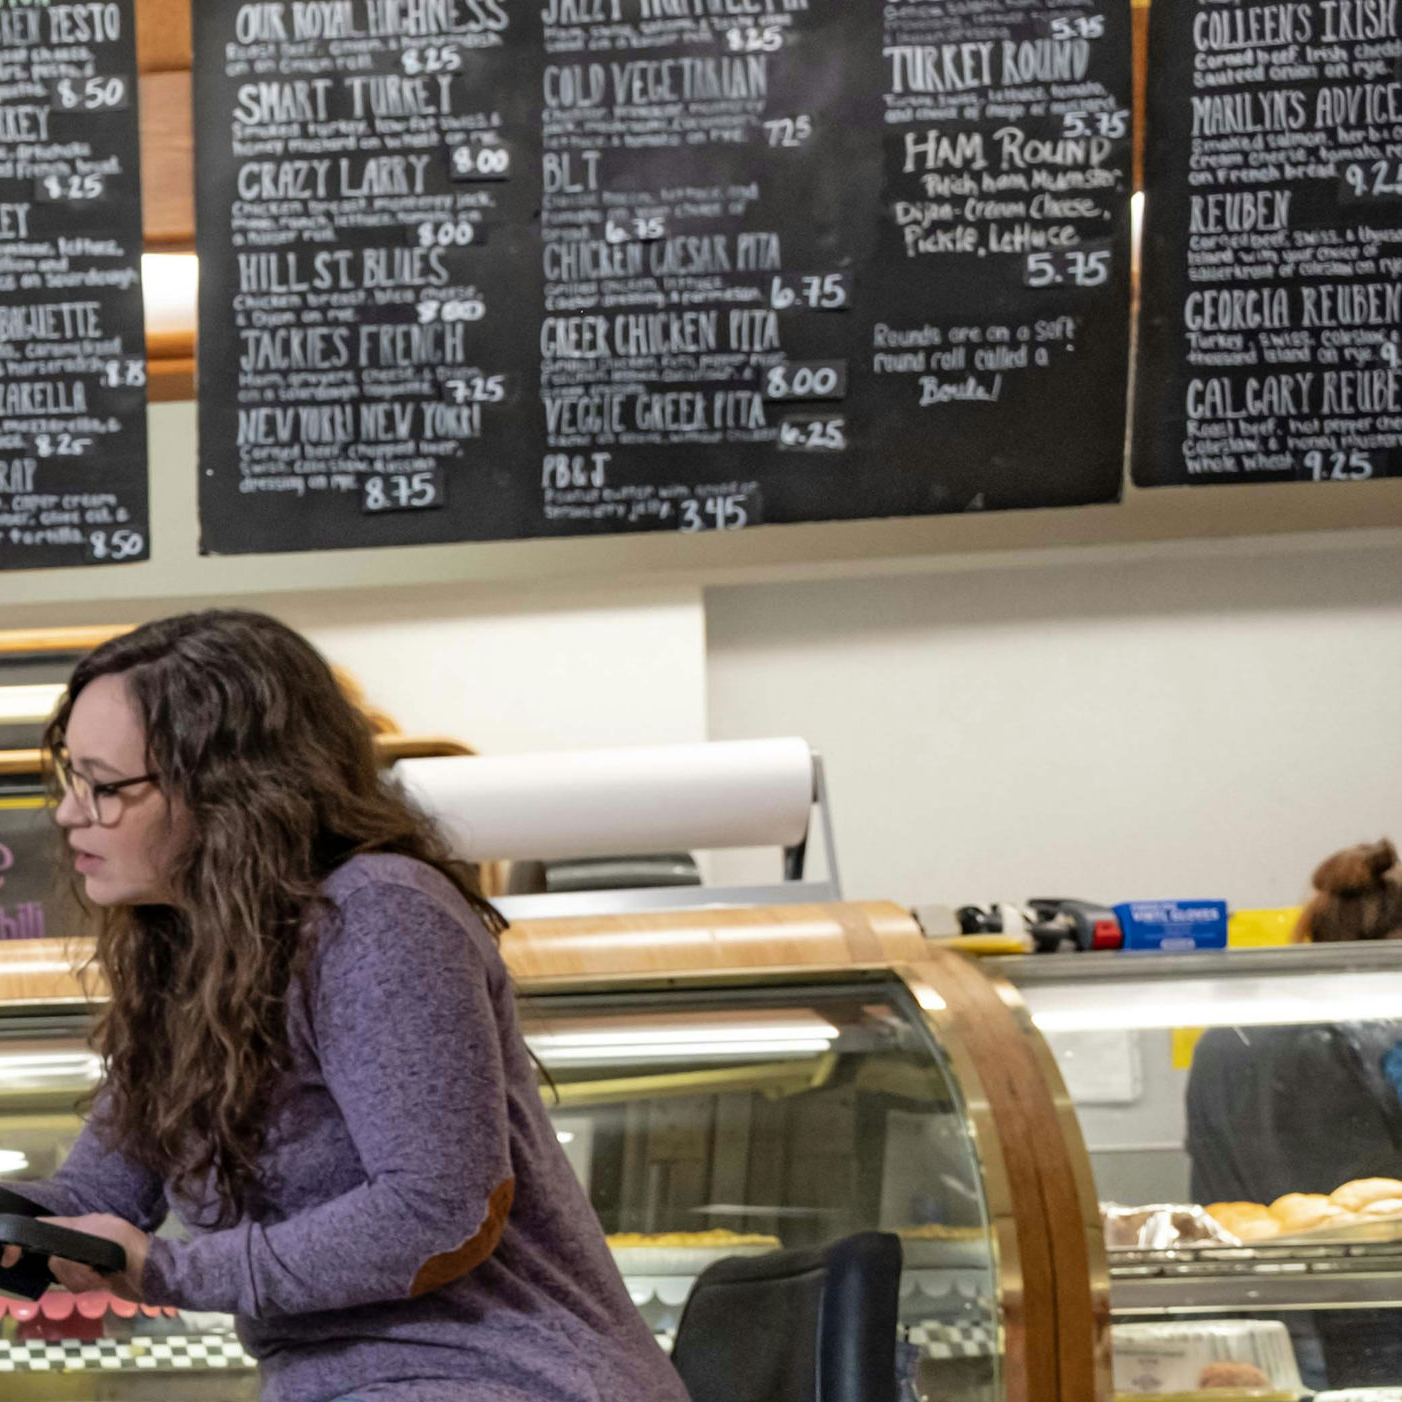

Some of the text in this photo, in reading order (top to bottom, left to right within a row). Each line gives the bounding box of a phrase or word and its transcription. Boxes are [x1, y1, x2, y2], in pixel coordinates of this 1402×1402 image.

[48, 4, 120, 44] PESTO
[236, 3, 286, 44] OUR
[293, 1, 367, 39] ROYAL
[367, 0, 510, 37] HIGHNESS
[1320, 0, 1397, 42] IRISH
[543, 54, 766, 108] COLD VEGETARIAN
[883, 39, 1090, 93] TURKEY ROUND
[233, 74, 453, 125] SMART TURKEY
[1315, 82, 1402, 127] ADVICE
[542, 151, 600, 193] BLT
[903, 126, 1112, 173] HAM ROUND
[238, 155, 430, 201] CRAZY LARRY
[1190, 189, 1291, 233] REUBEN
[238, 247, 448, 293] HILL BLUES
[544, 232, 781, 281] CHICKEN CAESAR PITA
[1185, 282, 1402, 331] GEORGIA REUBEN
[360, 322, 464, 367] FRENCH
[541, 309, 780, 358] GREEK CHICKEN PITA
[874, 323, 942, 347] Rounds
[948, 326, 982, 343] are
[986, 324, 1011, 342] on
[1016, 325, 1030, 341] a
[874, 345, 1049, 373] round roll called a
[544, 390, 766, 433] VEGGIE GREEK PITA
[1187, 372, 1314, 419] CALGARY
[237, 409, 294, 446] NEW
[361, 403, 414, 441] NEW
[542, 453, 612, 488] PB&J
